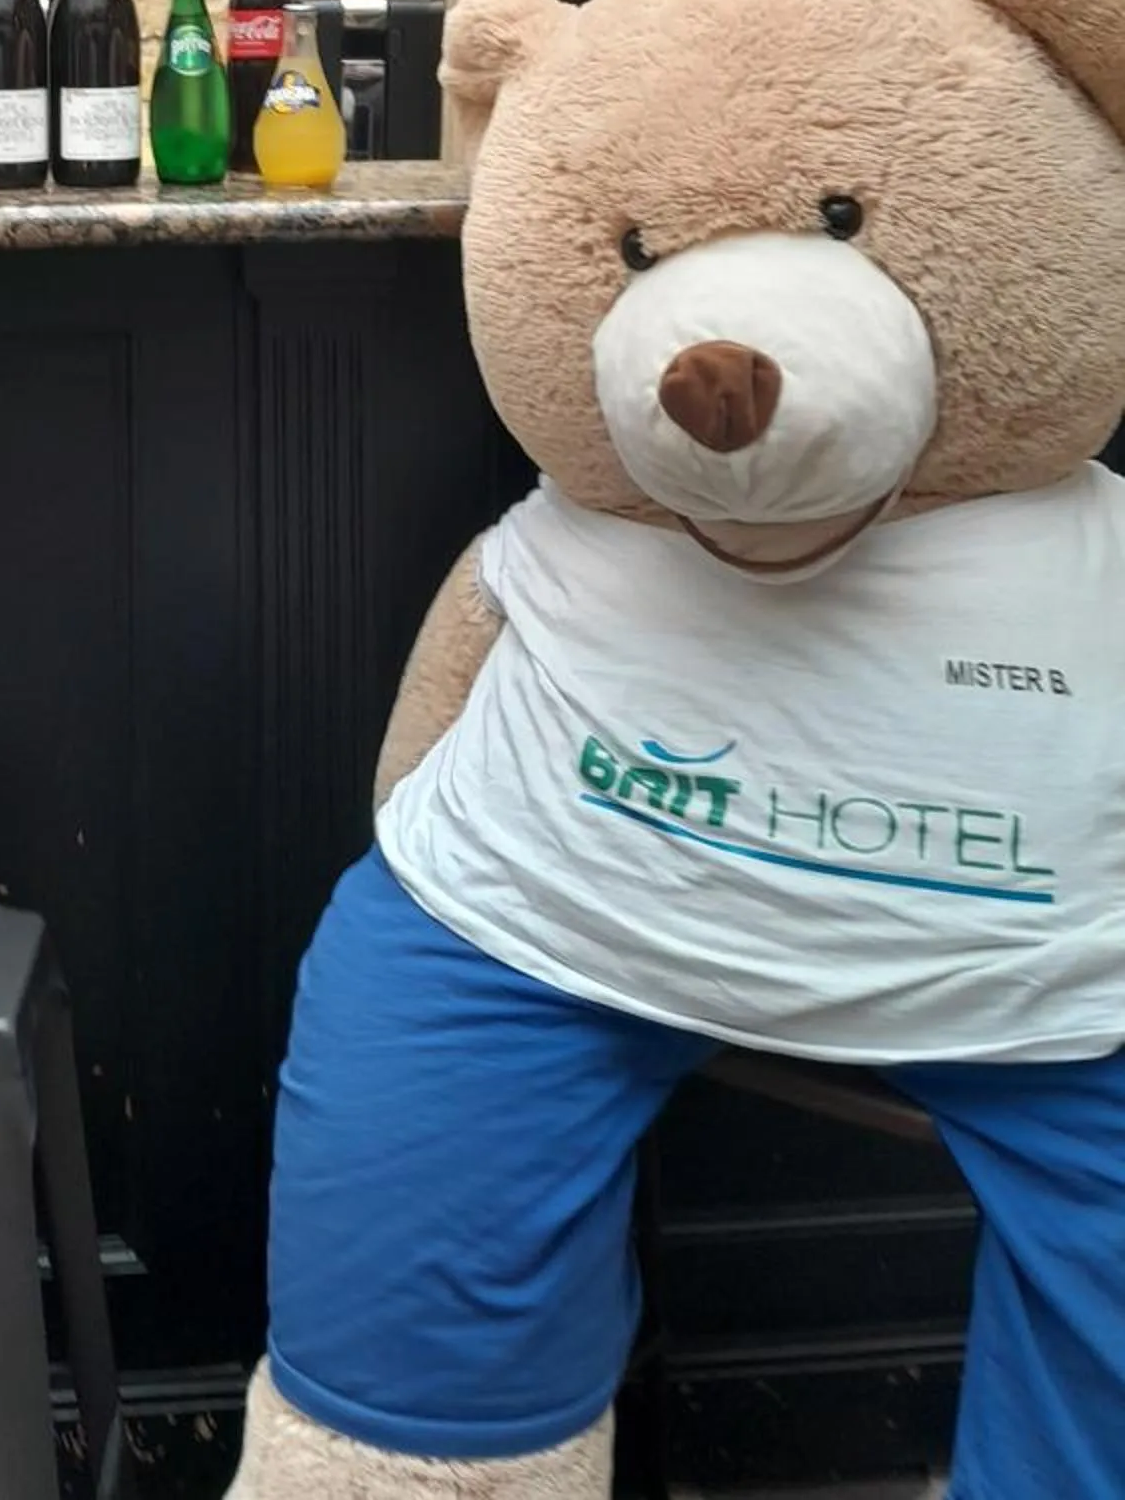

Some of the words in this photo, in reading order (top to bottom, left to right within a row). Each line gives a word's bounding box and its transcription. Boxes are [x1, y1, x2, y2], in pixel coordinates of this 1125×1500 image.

[945, 659, 1044, 693] MISTER
[578, 735, 740, 828] BRIT
[767, 786, 1055, 876] HOTEL
